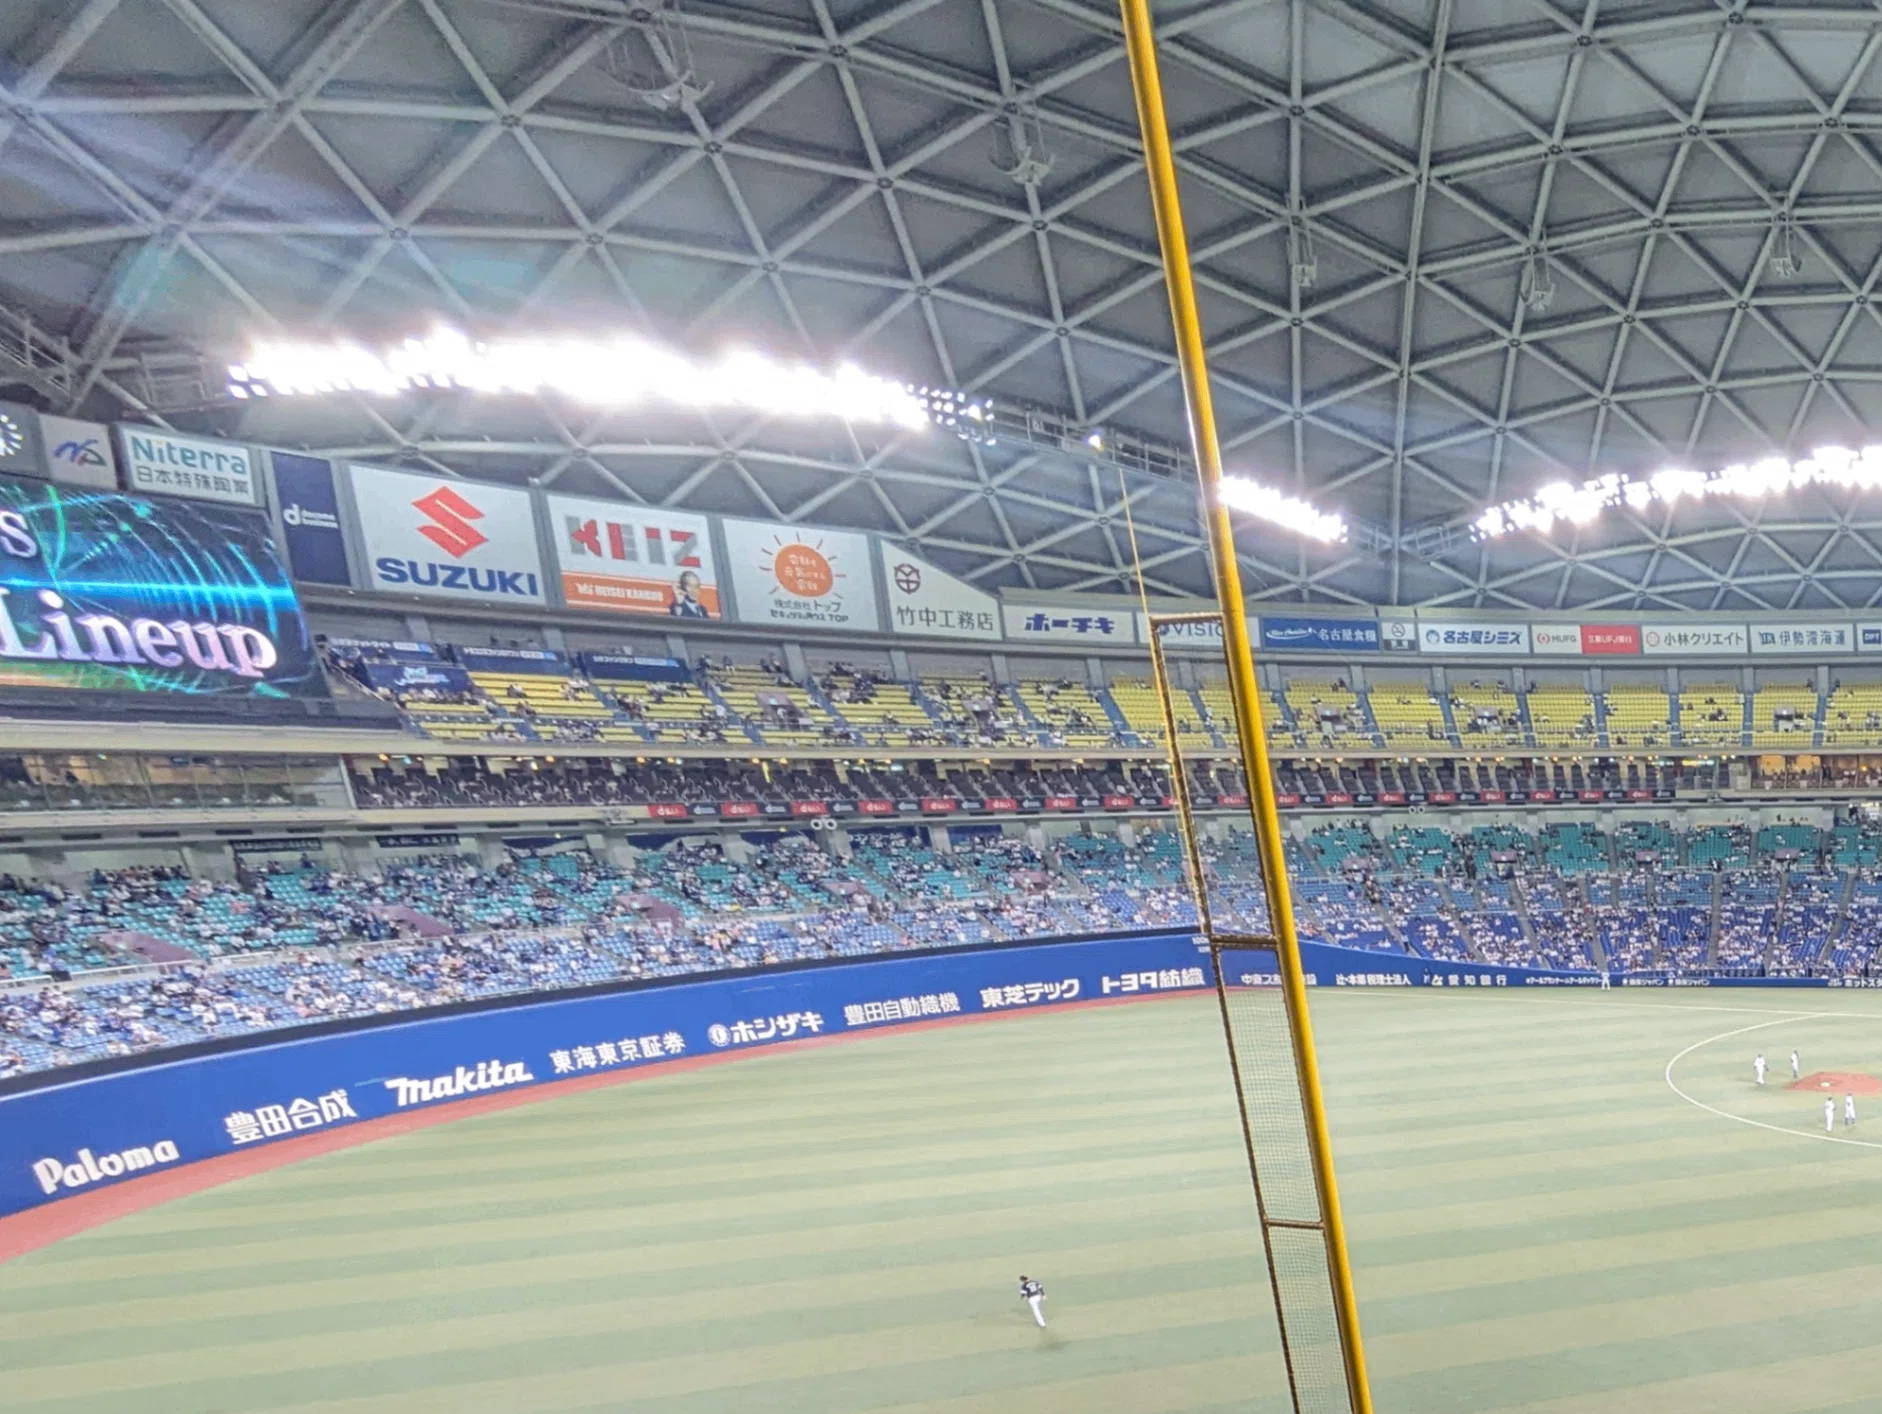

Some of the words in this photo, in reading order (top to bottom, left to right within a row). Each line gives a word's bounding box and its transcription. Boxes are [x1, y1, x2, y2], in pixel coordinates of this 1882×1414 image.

[131, 436, 248, 475] Niterra
[376, 557, 539, 596] SUZUKI
[813, 599, 842, 613] トップ
[828, 613, 849, 623] TOP
[896, 604, 994, 632] 竹中工務店
[0, 586, 278, 678] Lineup
[1025, 613, 1115, 635] ホーチキ
[1317, 628, 1377, 642] 名古屋食糧
[1443, 630, 1522, 646] 名古屋シミズ
[1779, 630, 1845, 646] 伊勢湾海運
[1551, 634, 1577, 643] MUFG
[1663, 630, 1744, 647] 小林クリエイト
[979, 977, 1080, 1008] 東芝テック
[1101, 967, 1206, 994] トヨタ紡織
[843, 992, 961, 1026] 豊田自動織機
[730, 1011, 824, 1044] ホシザキ
[549, 1031, 686, 1075] 東海東京証券
[224, 1088, 358, 1145] 豊田合成
[32, 1140, 180, 1195] Paloma
